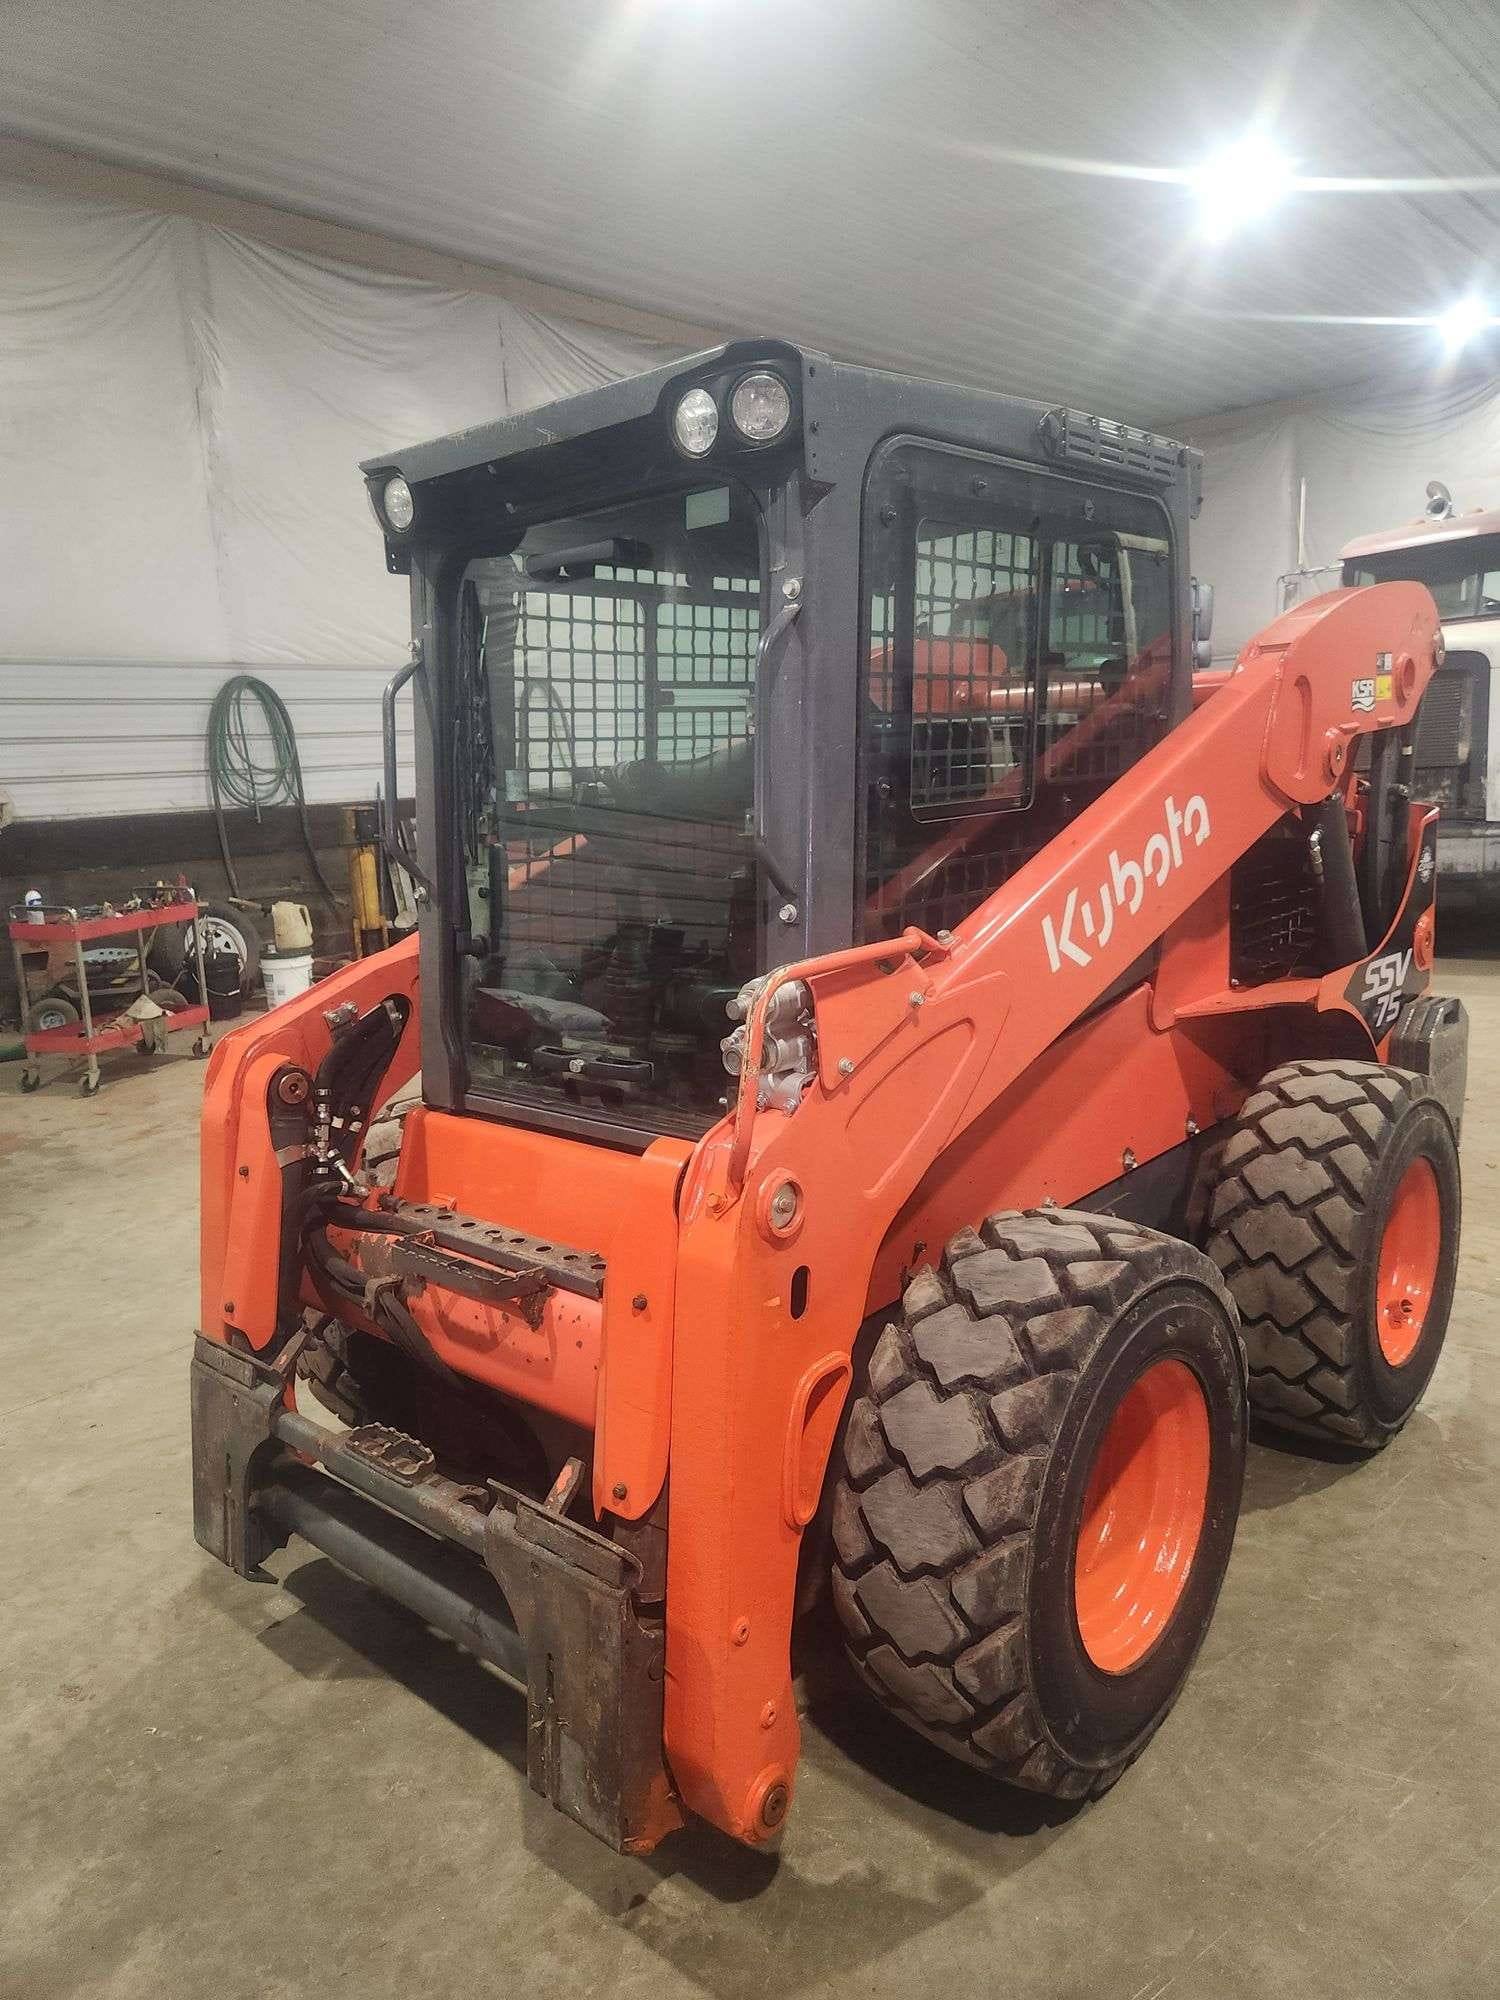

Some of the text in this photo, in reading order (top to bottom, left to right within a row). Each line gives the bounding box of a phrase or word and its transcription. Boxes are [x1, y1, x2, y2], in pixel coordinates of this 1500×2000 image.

[1041, 795, 1211, 973] Kubota
[1361, 947, 1413, 1001] SSV
[1375, 989, 1402, 1027] 75
